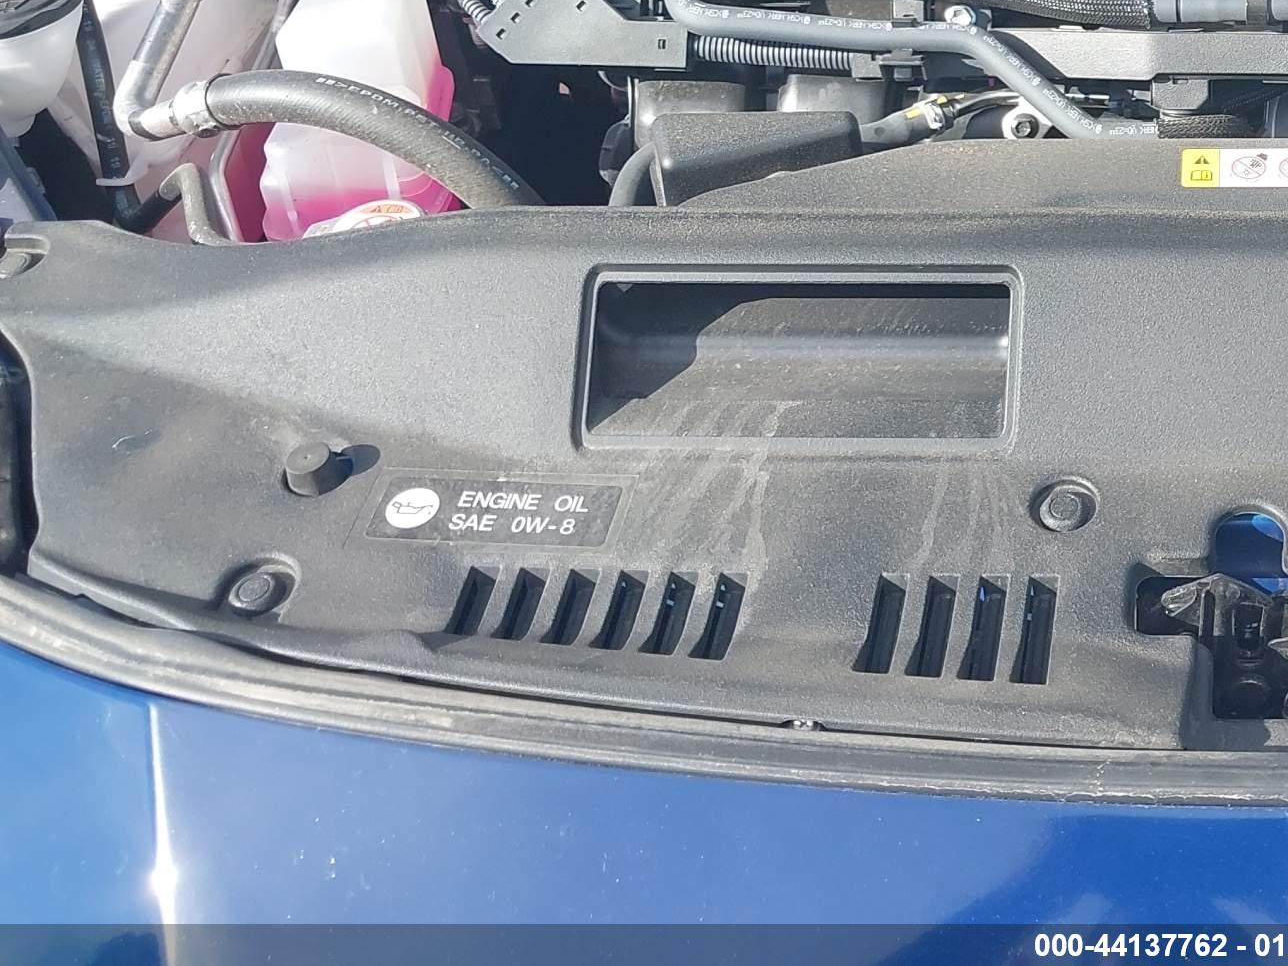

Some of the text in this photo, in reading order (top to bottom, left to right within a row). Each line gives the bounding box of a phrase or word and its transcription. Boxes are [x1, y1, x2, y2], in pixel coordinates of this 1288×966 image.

[457, 490, 589, 513] ENGINE OIL
[448, 513, 576, 535] SAE 0W-8
